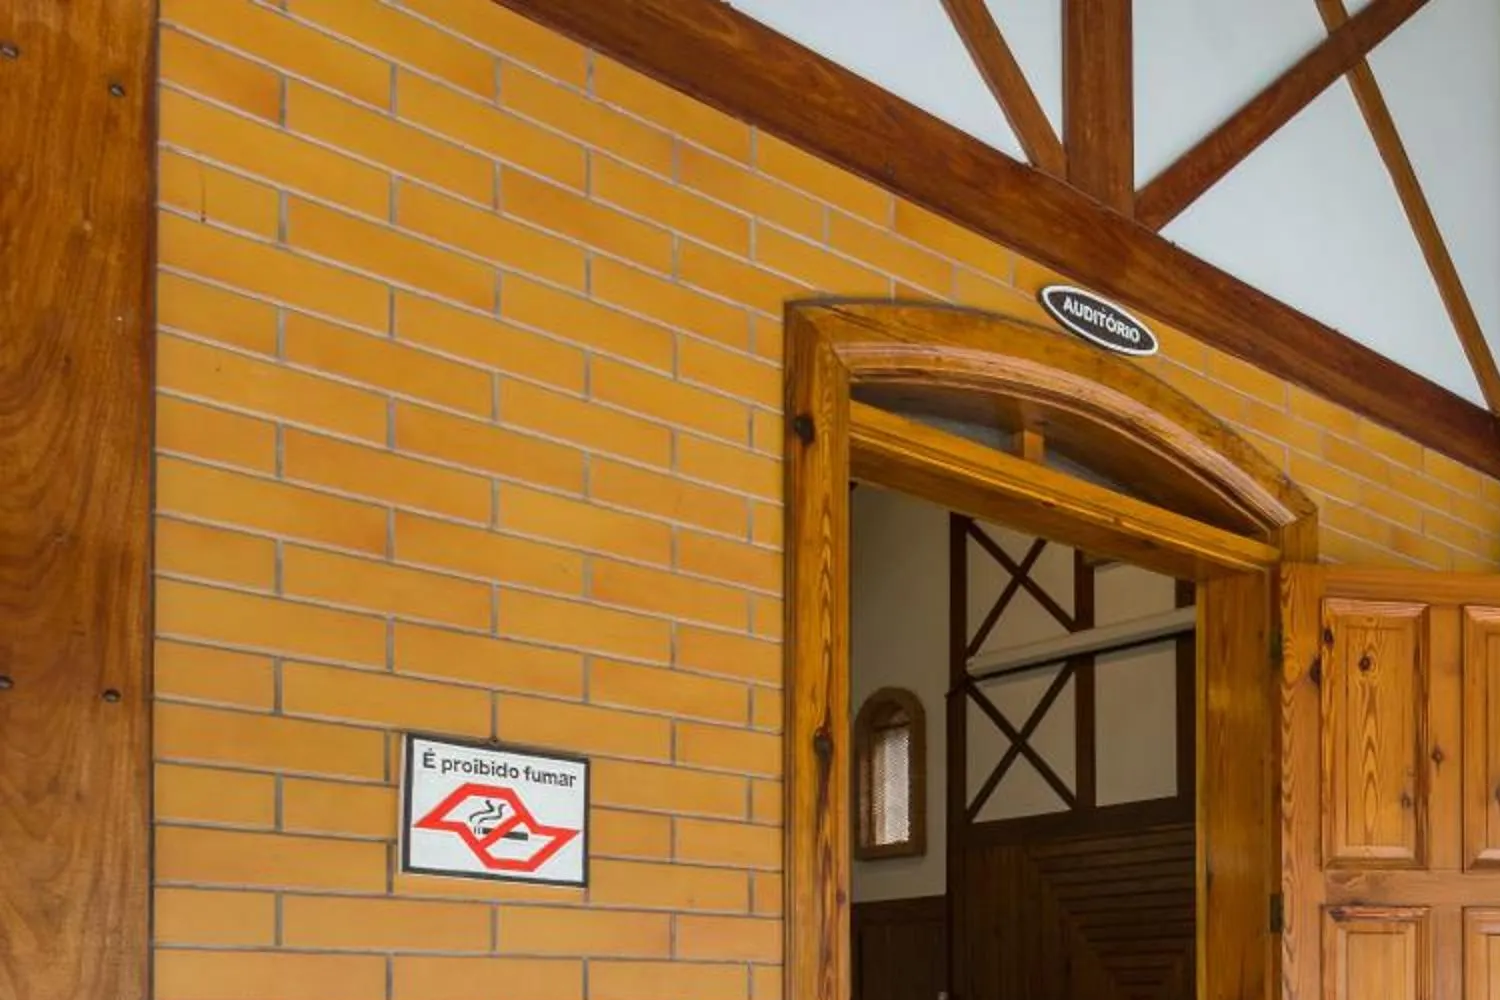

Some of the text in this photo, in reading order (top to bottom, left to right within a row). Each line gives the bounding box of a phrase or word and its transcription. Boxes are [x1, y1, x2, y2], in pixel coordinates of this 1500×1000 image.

[1062, 296, 1141, 343] AUDITÓRIO
[423, 748, 577, 789] É proibido fumar
